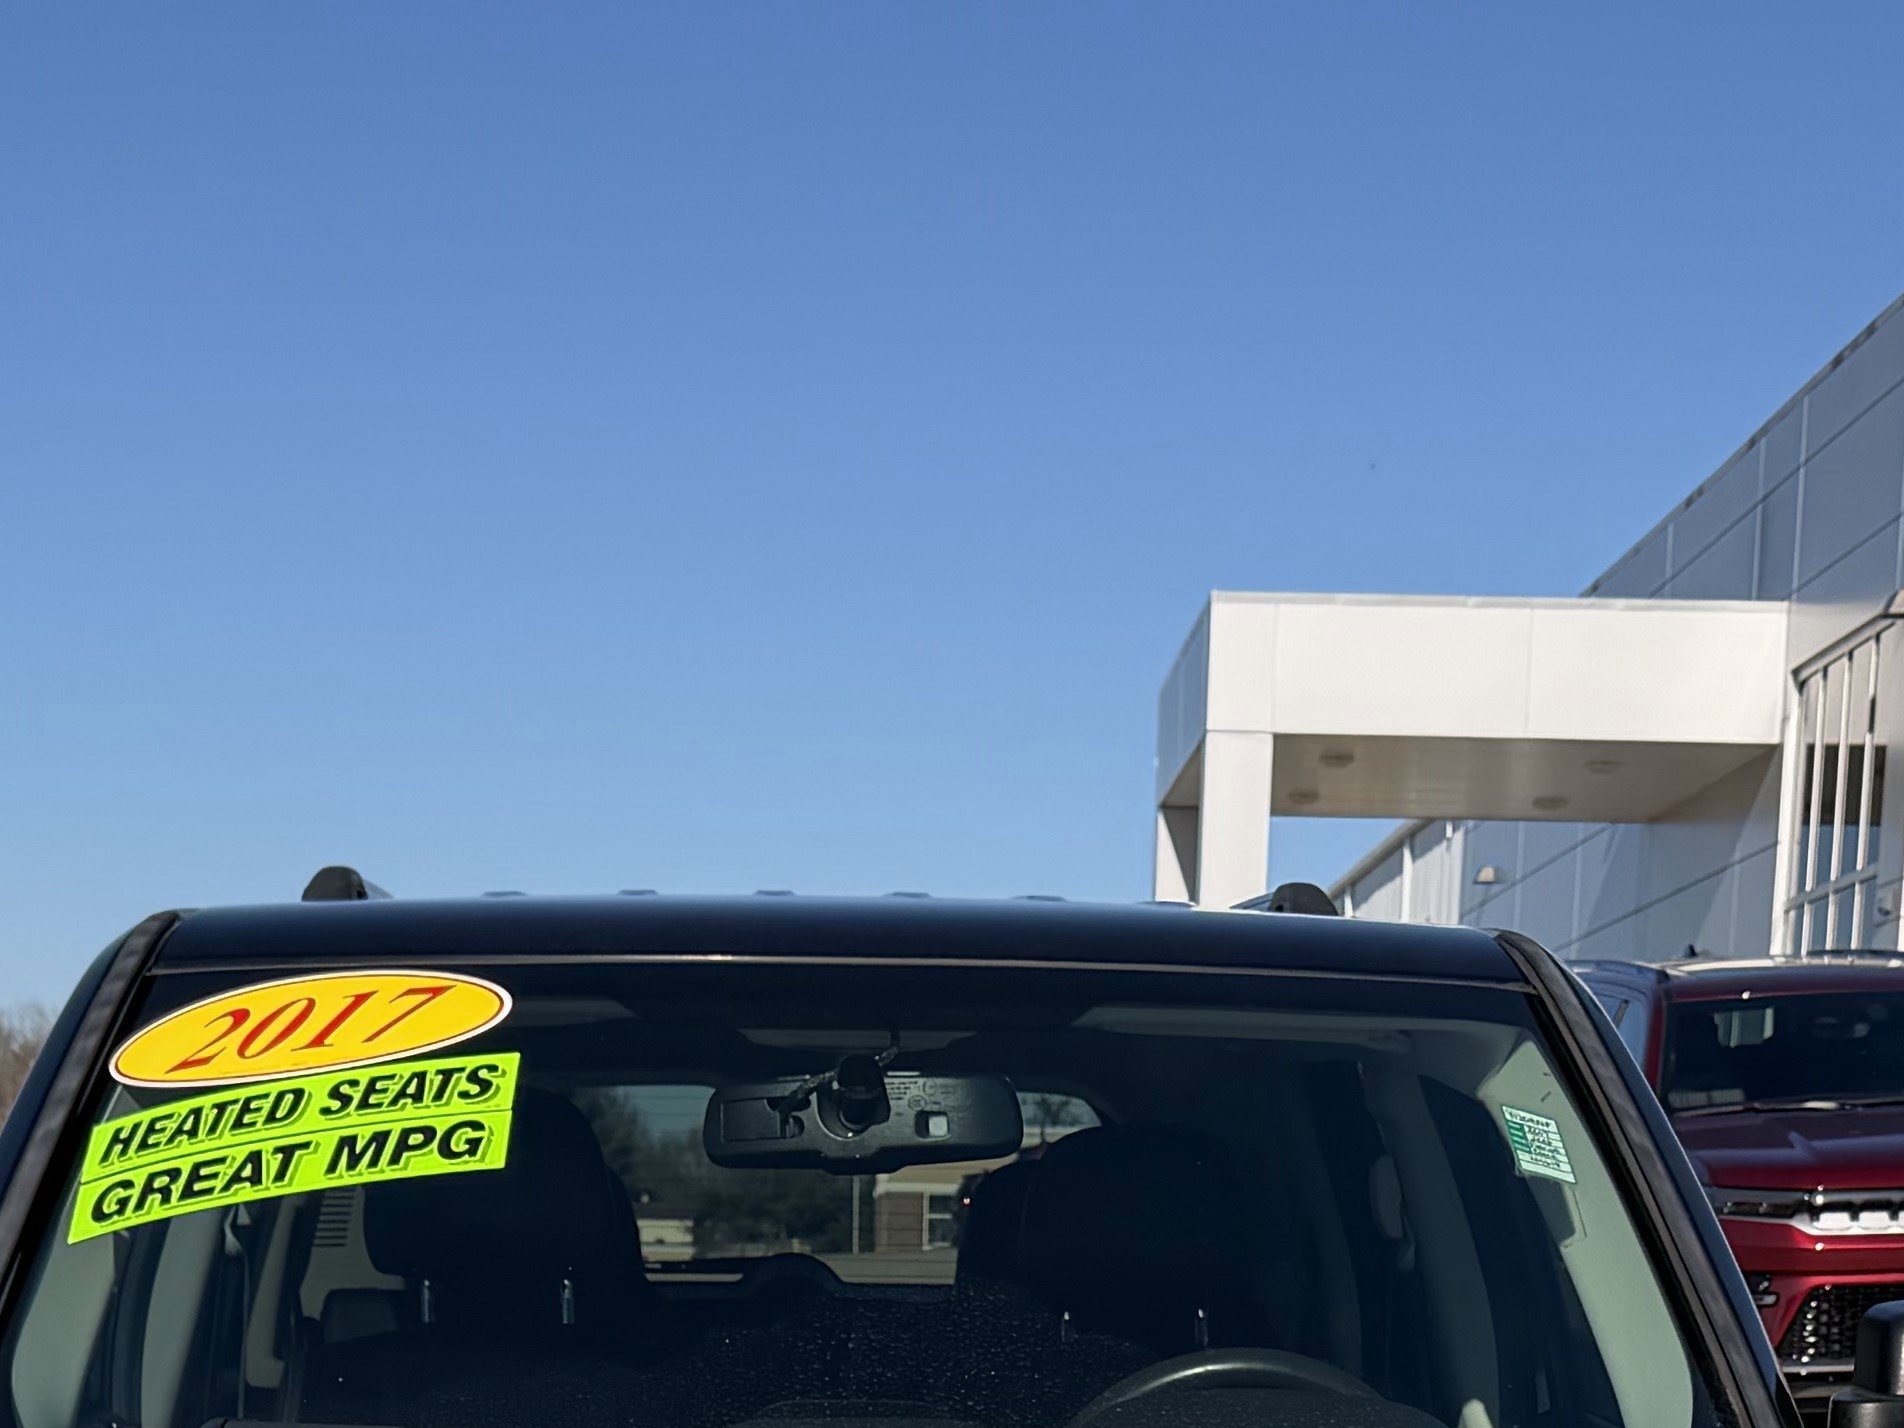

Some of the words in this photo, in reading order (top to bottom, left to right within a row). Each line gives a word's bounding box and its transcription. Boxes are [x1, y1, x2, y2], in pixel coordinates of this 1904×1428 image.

[164, 984, 458, 1074] 2017
[99, 1087, 310, 1167] HEATED
[319, 1063, 506, 1118] SEATS
[91, 1140, 319, 1225] GREAT
[325, 1120, 491, 1178] MPG
